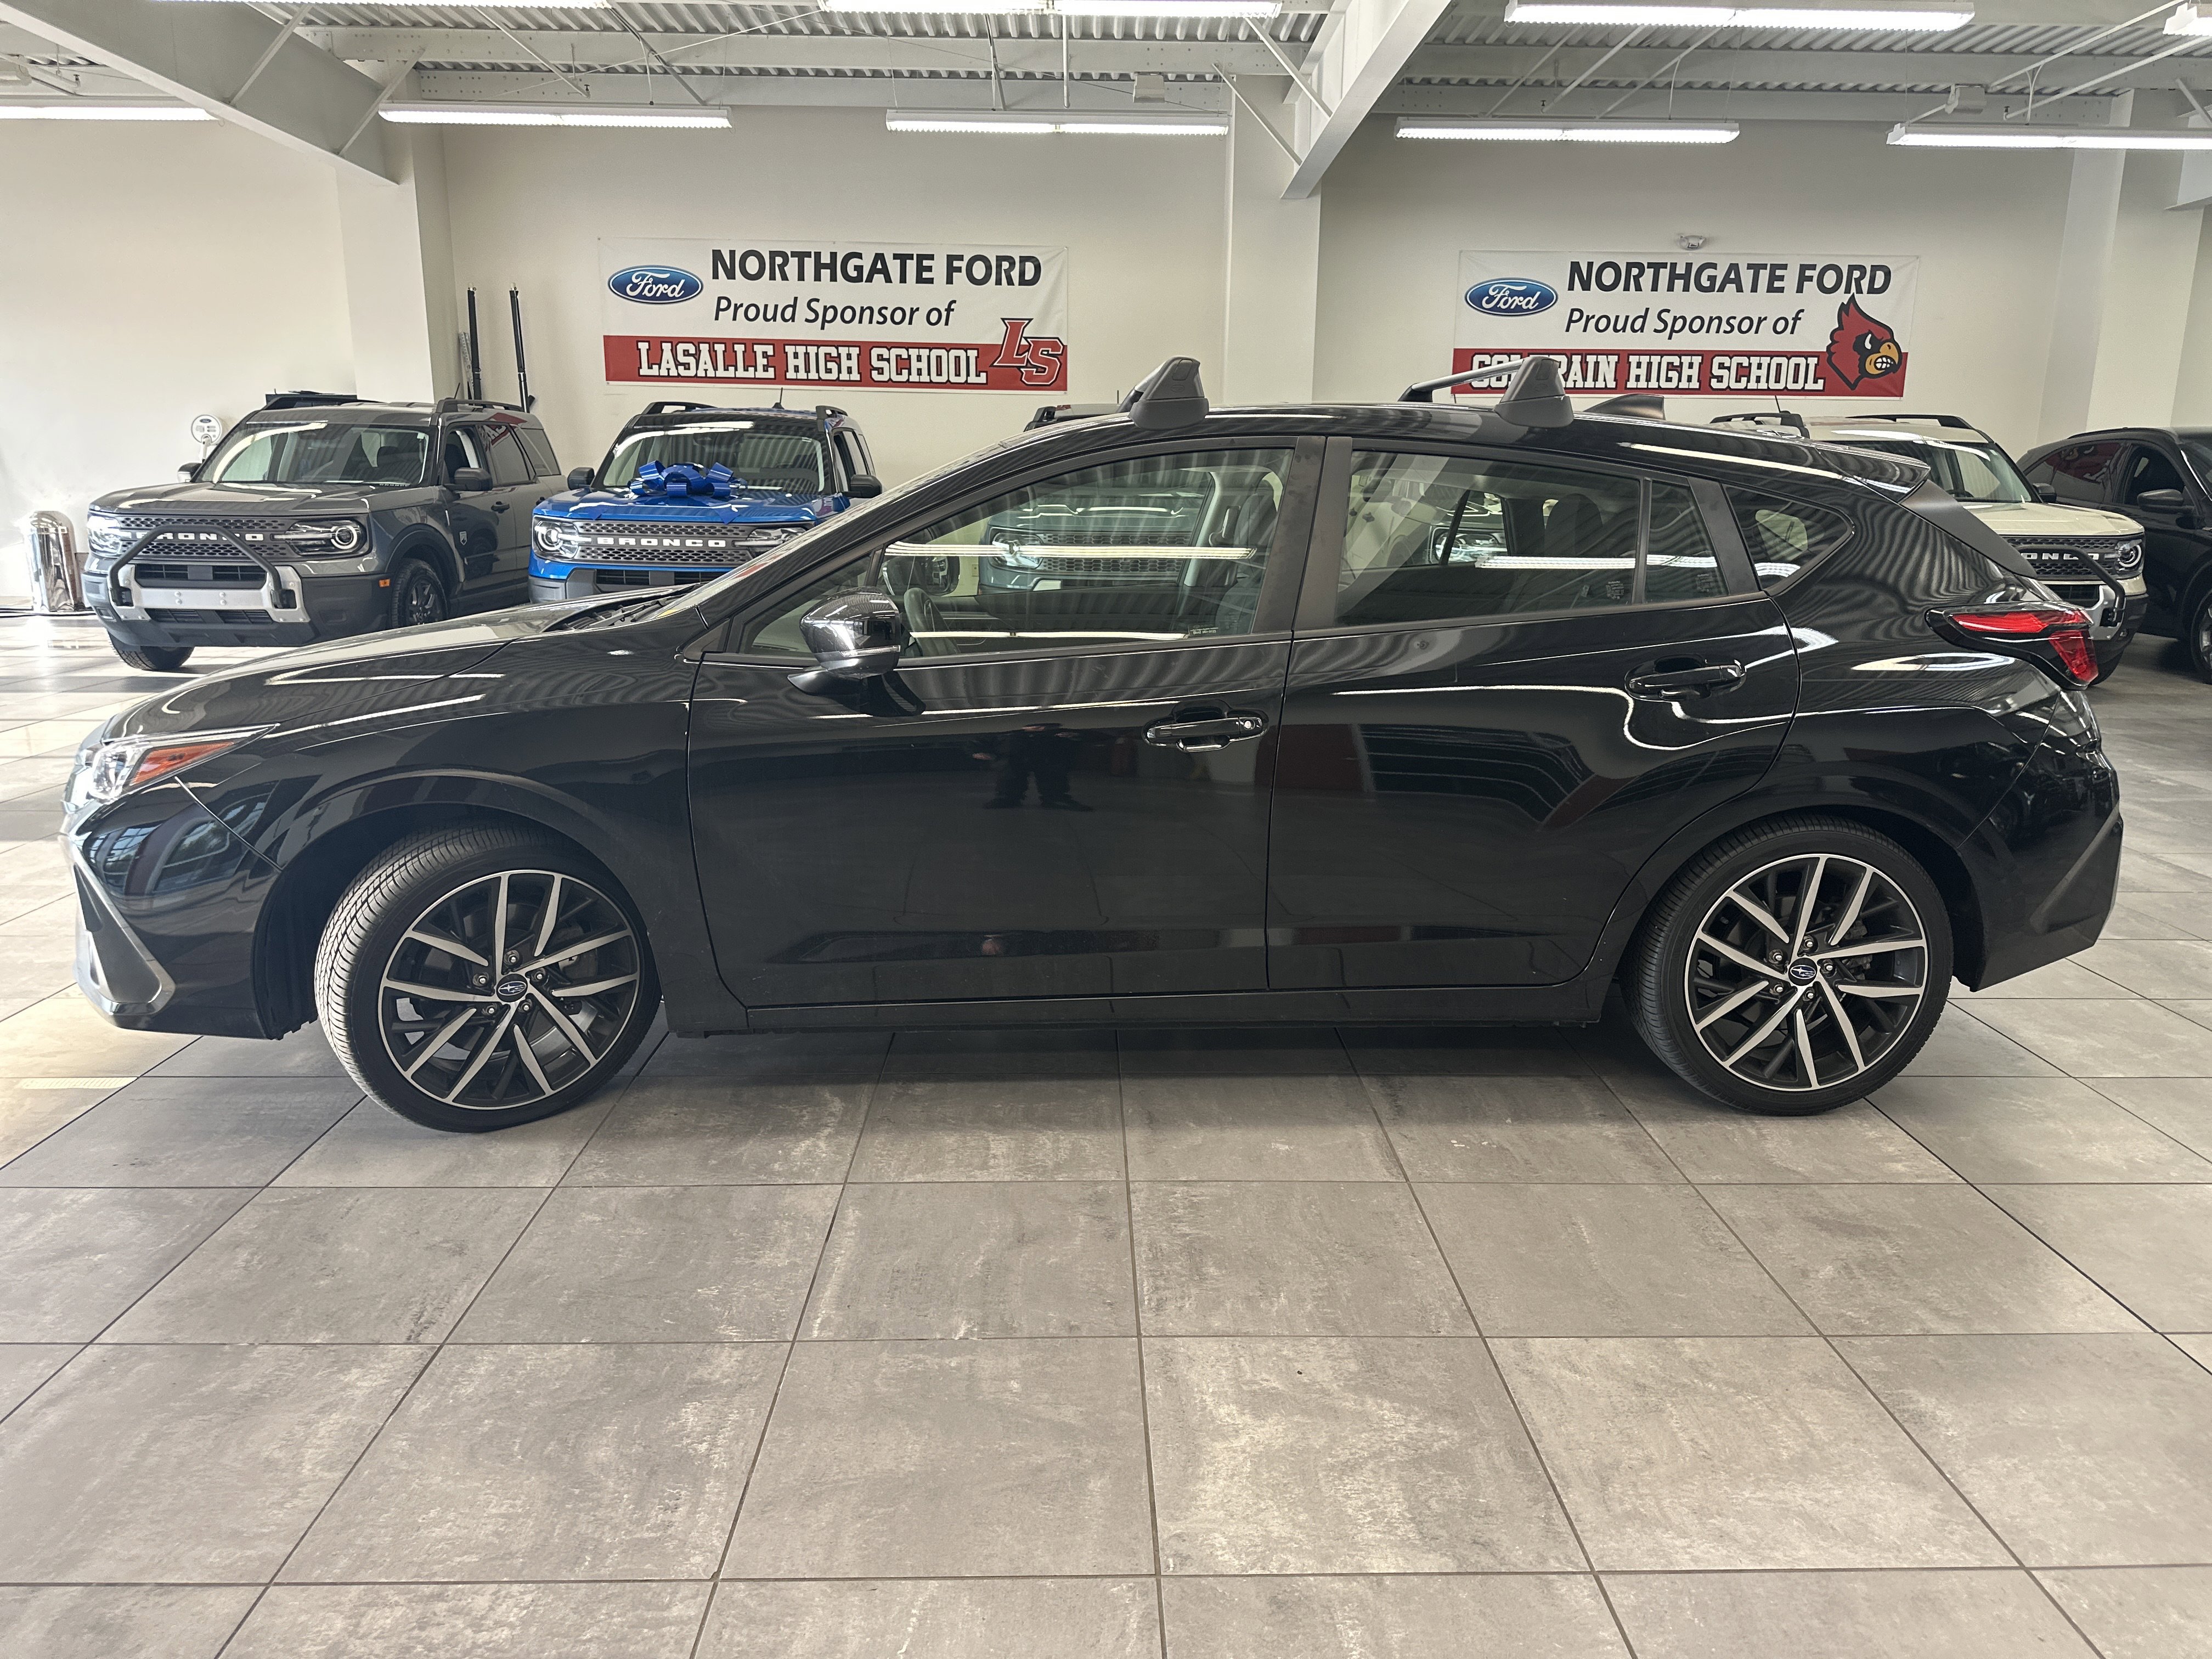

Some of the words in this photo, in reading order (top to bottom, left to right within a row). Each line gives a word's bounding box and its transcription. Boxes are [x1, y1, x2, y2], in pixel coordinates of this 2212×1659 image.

[626, 271, 685, 297] Ford
[712, 250, 934, 285] NORTHGATE
[946, 254, 1041, 286] FORD
[1567, 261, 1788, 293] NORTHGATE
[1796, 264, 1891, 295] FORD
[714, 296, 798, 323] Proud
[804, 298, 919, 330] Sponsor
[926, 300, 956, 326] of
[1481, 284, 1541, 309] Ford
[1565, 307, 1649, 333] Proud
[1653, 308, 1767, 340] Sponsor
[1773, 308, 1804, 334] of
[636, 341, 775, 380] LASALLE
[784, 345, 861, 381] HIGH
[870, 347, 988, 385] SCHOOL
[989, 318, 1064, 386] LS
[1470, 353, 1620, 390] CORAIN
[1626, 354, 1703, 390] HIGH
[1709, 356, 1826, 392] SCHOOL
[136, 532, 263, 541] RONO
[597, 537, 726, 548] BRONCO
